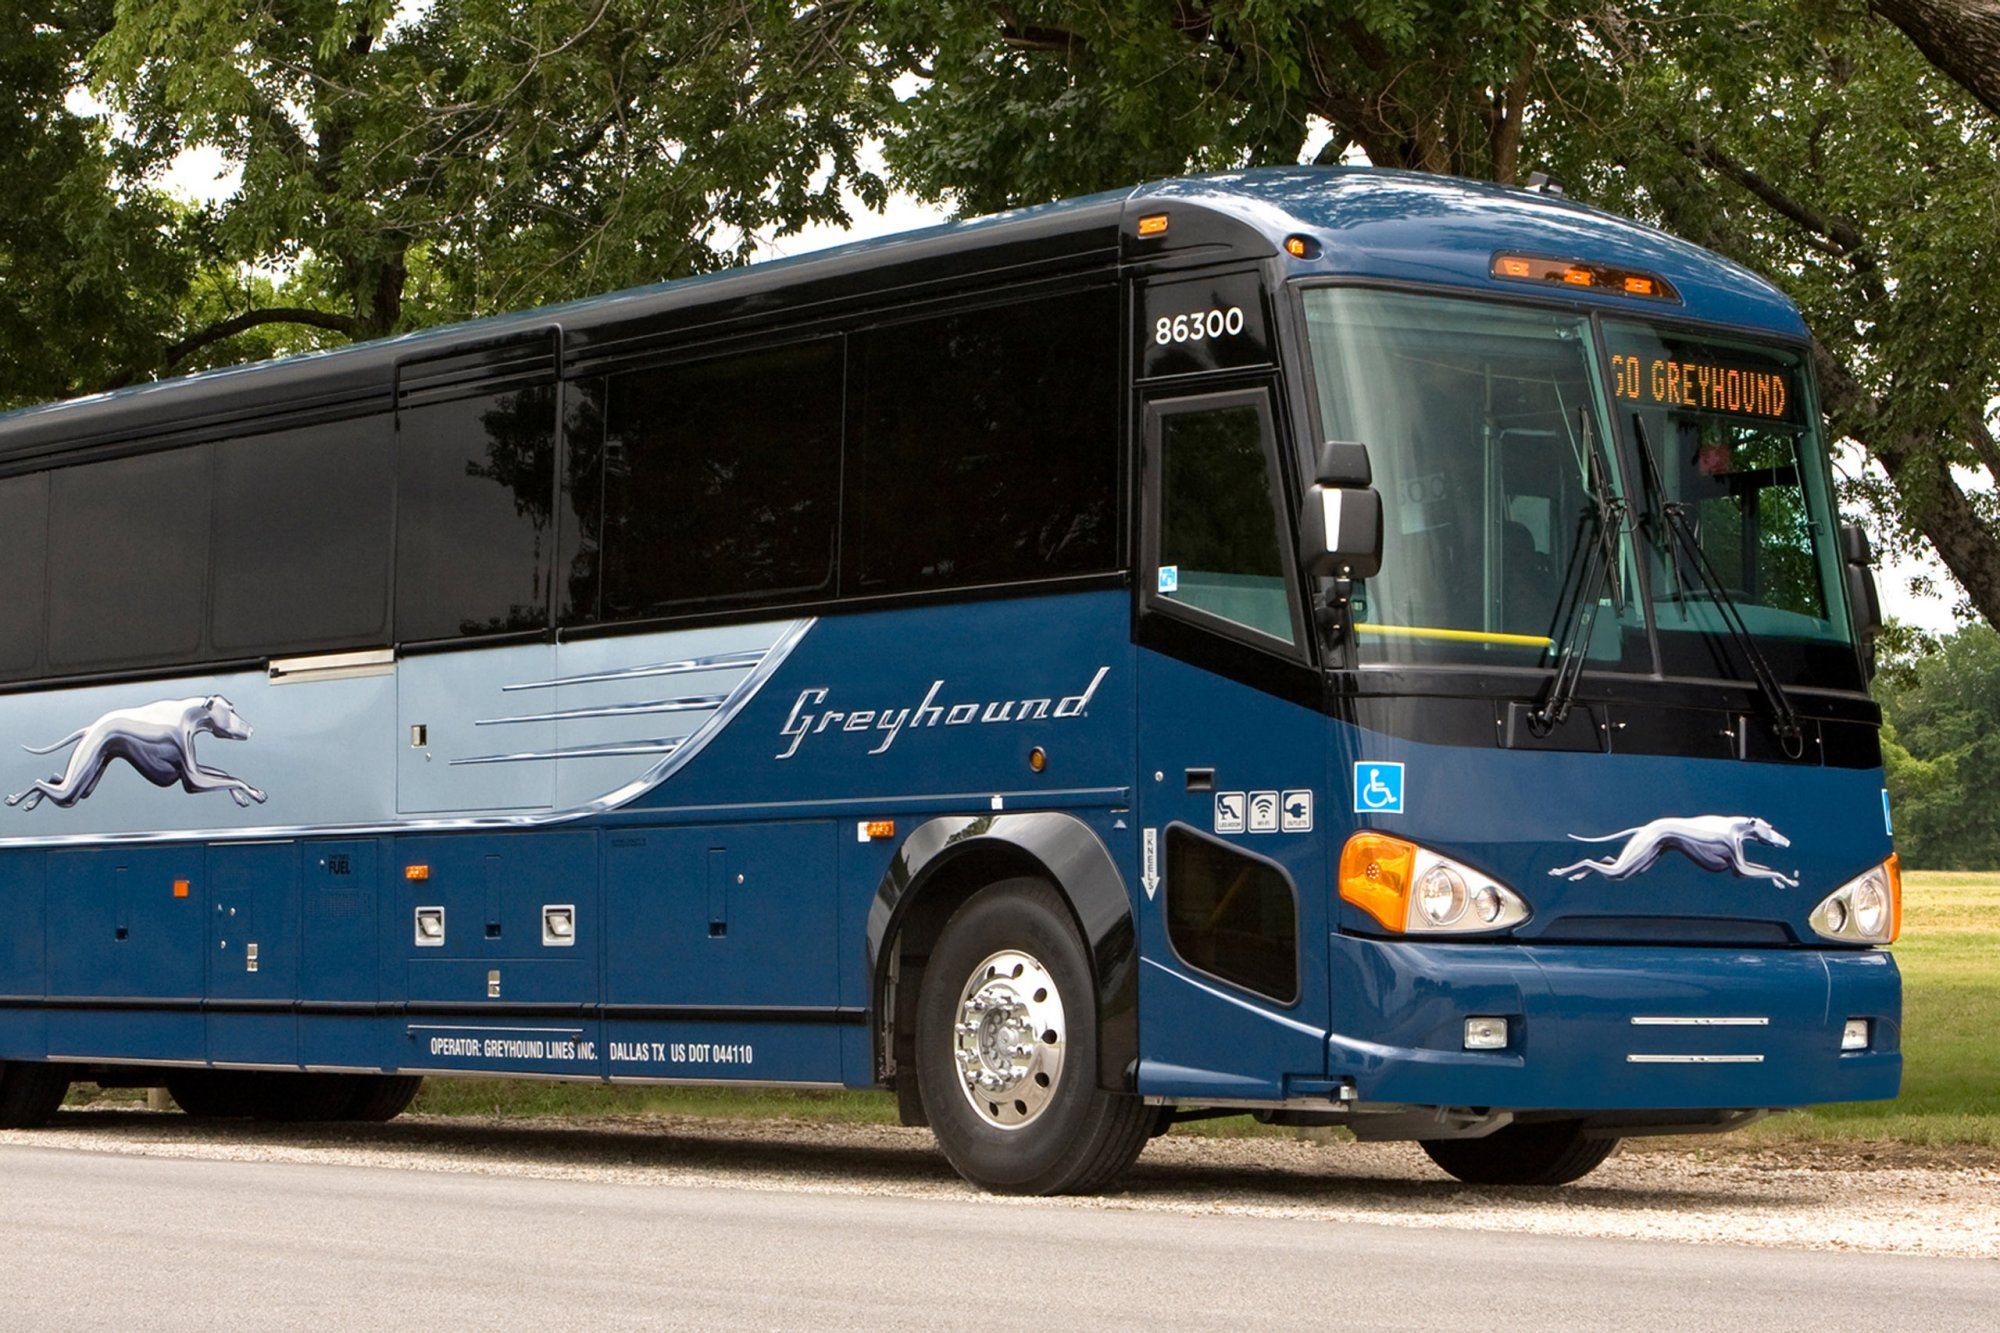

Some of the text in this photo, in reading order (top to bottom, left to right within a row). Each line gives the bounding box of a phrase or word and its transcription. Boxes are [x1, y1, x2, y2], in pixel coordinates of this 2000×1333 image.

[1155, 306, 1244, 345] 86300
[1611, 354, 1785, 417] GO GREYHOUND
[775, 666, 1110, 759] Greyhound
[328, 860, 351, 875] FUEL
[431, 1037, 753, 1064] OPERATOR: GREYHOUND LINES INC. DALLAS TX US DOT 044110
